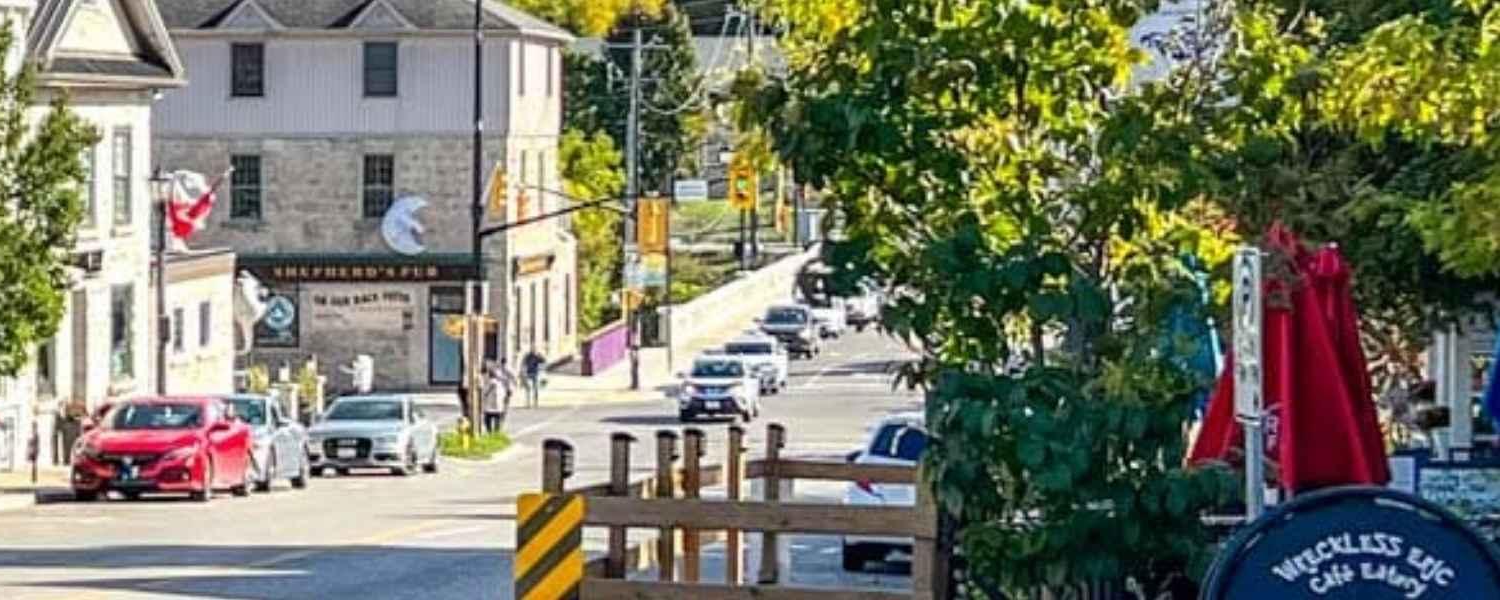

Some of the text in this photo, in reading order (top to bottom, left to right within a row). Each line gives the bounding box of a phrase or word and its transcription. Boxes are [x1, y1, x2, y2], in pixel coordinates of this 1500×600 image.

[274, 266, 437, 278] SHEPHERD'S PUB
[1272, 532, 1455, 586] WRECKLESS ERIC
